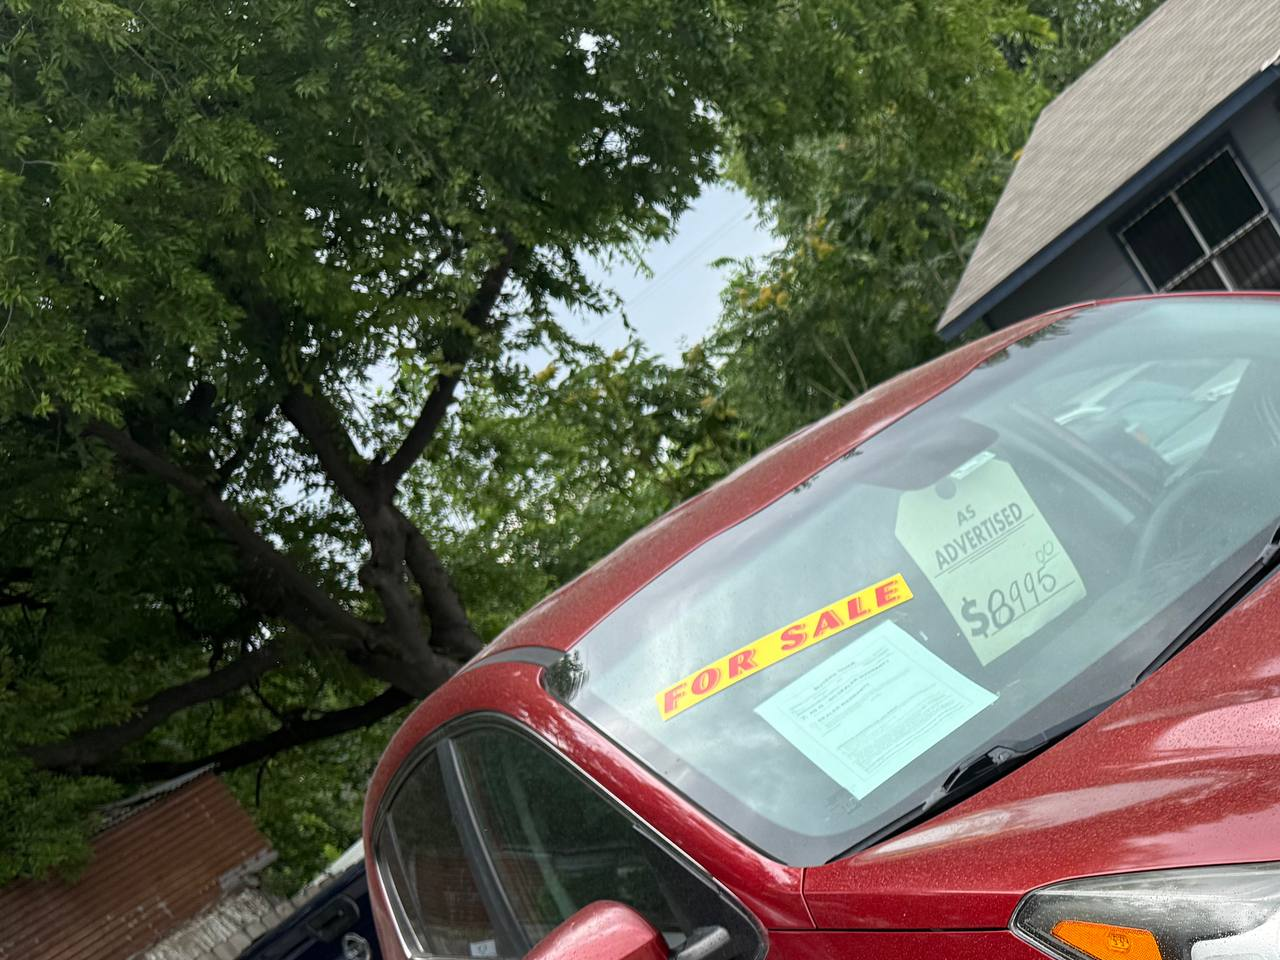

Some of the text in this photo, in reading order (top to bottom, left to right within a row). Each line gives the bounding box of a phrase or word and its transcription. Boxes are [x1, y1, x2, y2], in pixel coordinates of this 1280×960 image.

[934, 502, 1023, 571] ADVERTISED
[956, 503, 977, 527] AS
[663, 647, 758, 715] FOR
[780, 579, 902, 652] SALE
